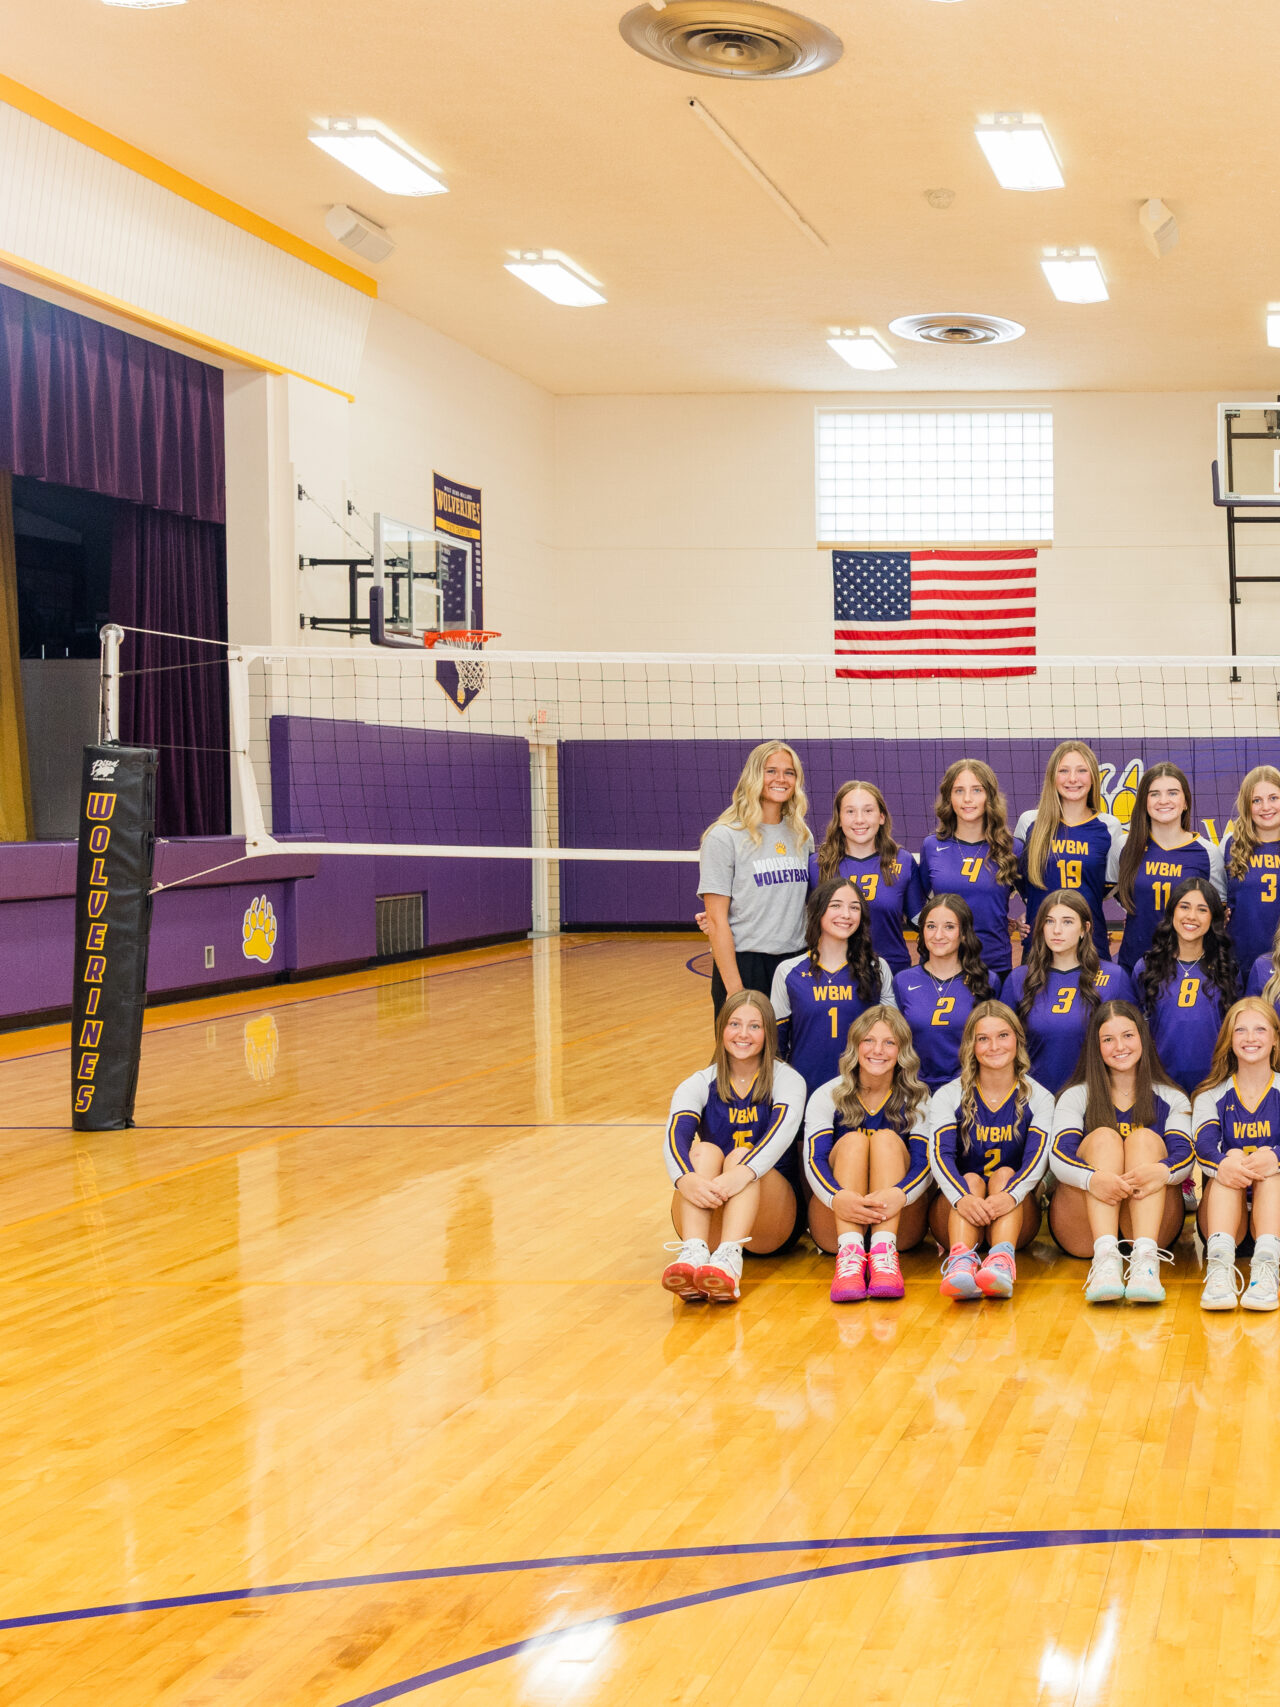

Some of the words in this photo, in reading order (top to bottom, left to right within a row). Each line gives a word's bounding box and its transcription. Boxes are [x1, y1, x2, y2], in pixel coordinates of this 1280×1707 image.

[435, 488, 480, 524] WOLVERINES
[1051, 839, 1089, 855] WBM
[960, 857, 984, 883] 4
[1056, 859, 1082, 889] 19
[1145, 861, 1182, 877] WBM
[1152, 881, 1172, 911] 11
[1260, 873, 1278, 902] 3
[75, 792, 117, 1112] WOLVERINES
[812, 985, 853, 1001] WBM
[1051, 987, 1077, 1014] 3
[1177, 978, 1201, 1008] 8
[828, 1006, 838, 1038] 1
[930, 996, 956, 1026] 2
[976, 1124, 1012, 1143] WBM
[1232, 1120, 1272, 1139] WBM
[983, 1148, 1001, 1178] 2
